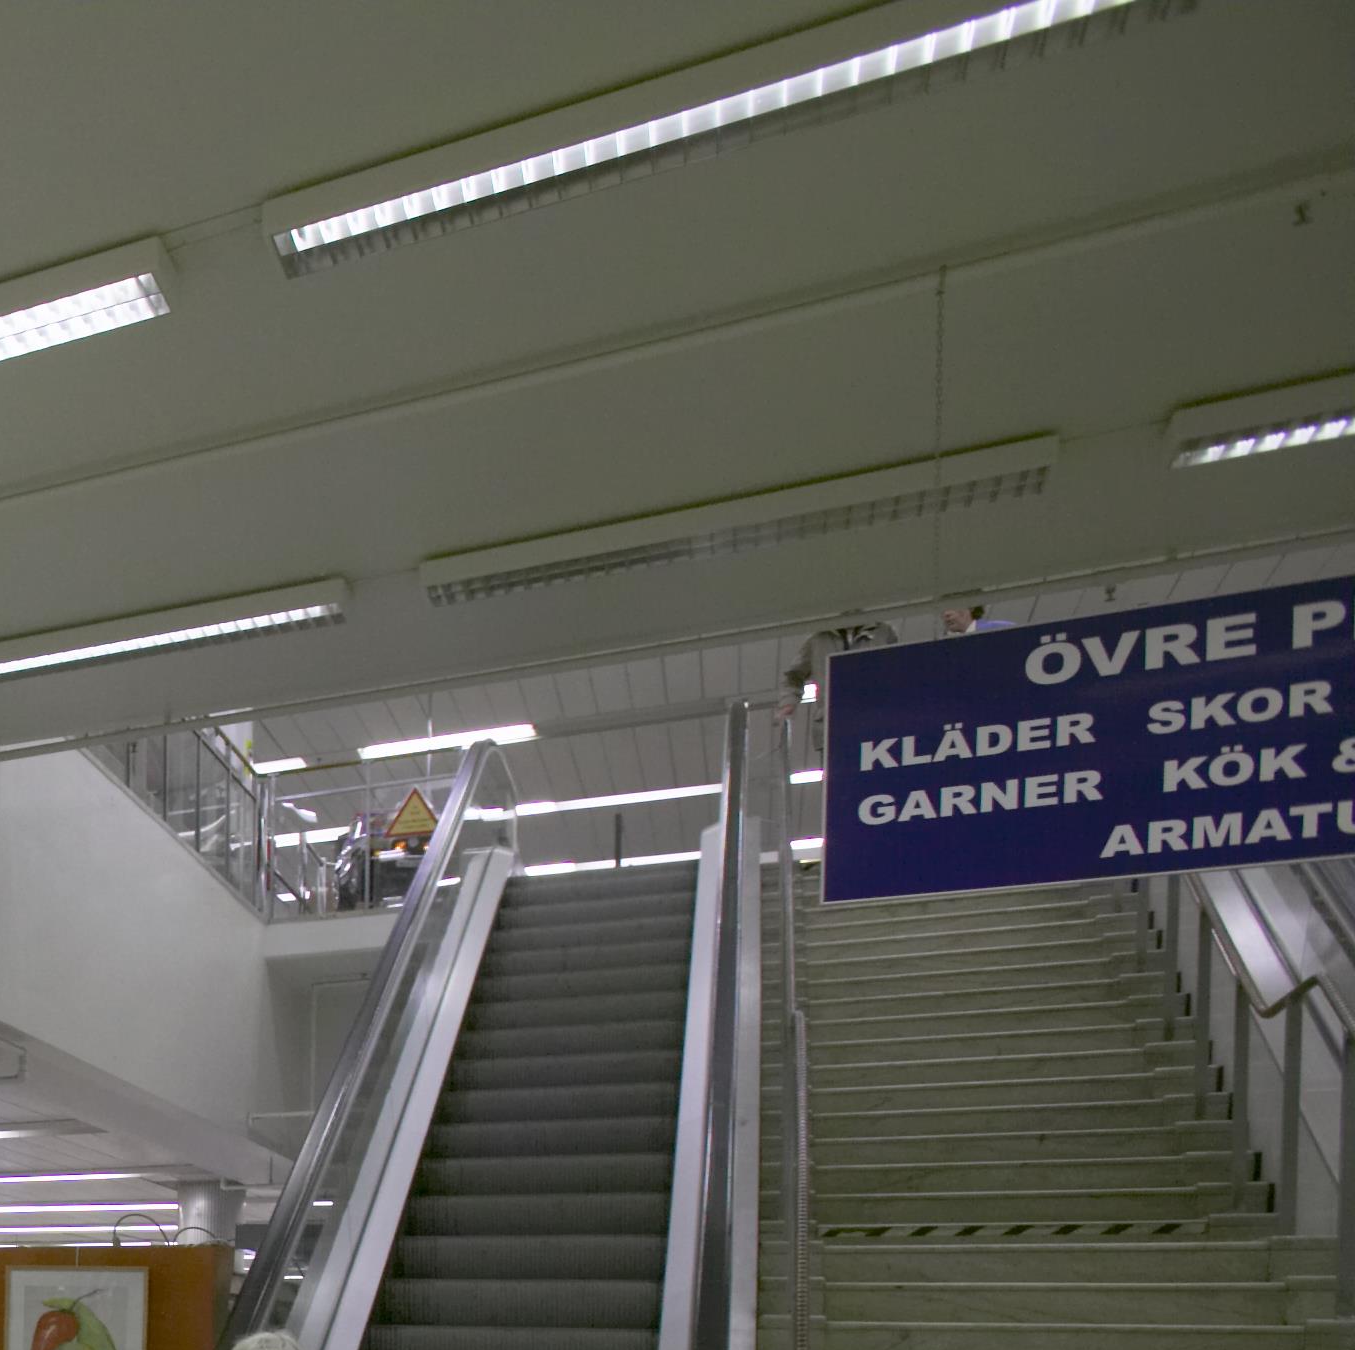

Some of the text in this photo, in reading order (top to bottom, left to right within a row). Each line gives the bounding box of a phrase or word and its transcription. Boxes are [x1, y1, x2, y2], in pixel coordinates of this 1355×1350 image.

[1024, 599, 1355, 686] ÖVRE P
[1146, 680, 1333, 735] SKOR
[859, 712, 1096, 772] KLÄDER
[1162, 743, 1307, 793] KÖK
[858, 769, 1103, 826] GARNER
